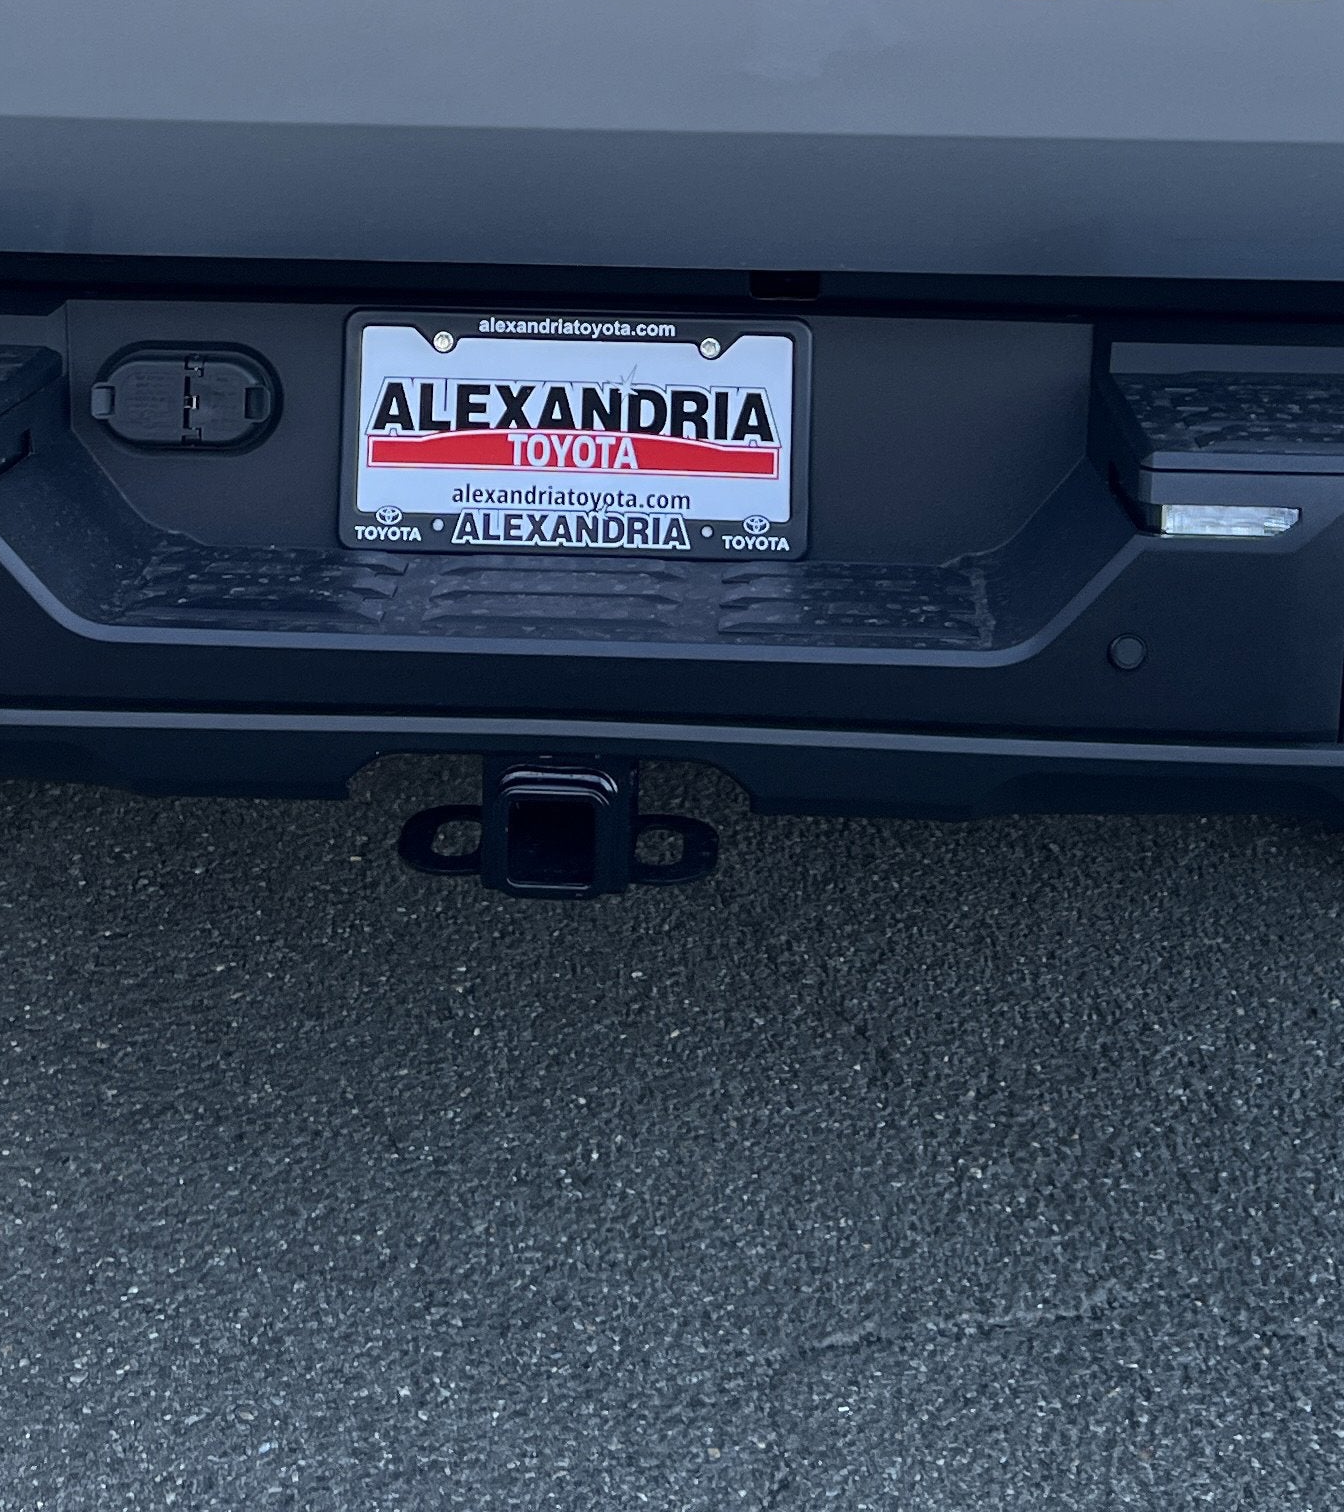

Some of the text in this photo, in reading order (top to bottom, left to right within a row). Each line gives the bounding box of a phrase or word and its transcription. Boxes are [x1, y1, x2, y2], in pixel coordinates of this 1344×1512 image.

[478, 317, 676, 339] alexandriatoyota.com
[371, 380, 776, 443] ALEXANDRIA
[506, 433, 639, 470] TOYOTA
[451, 483, 692, 512] alexandriatoyota.com
[354, 524, 422, 543] TOYOTA
[452, 509, 691, 550] ALEXANDRIA
[721, 534, 790, 552] TOYOTA
